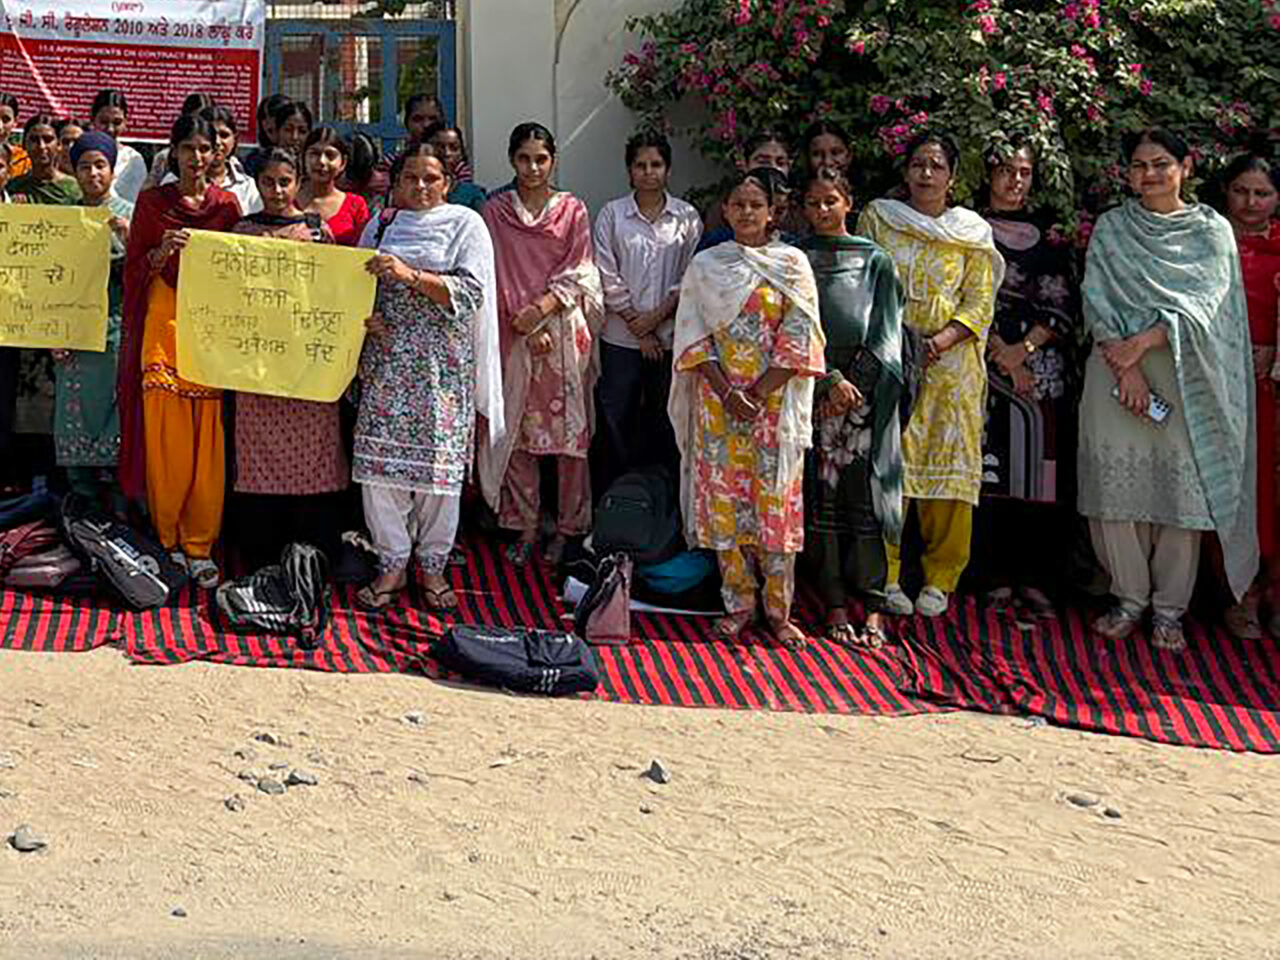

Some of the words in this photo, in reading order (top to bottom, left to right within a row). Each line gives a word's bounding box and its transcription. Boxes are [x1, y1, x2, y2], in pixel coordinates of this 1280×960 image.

[114, 17, 143, 35] 2010
[147, 16, 169, 36] ਅਤੇ
[173, 21, 204, 39] 2018
